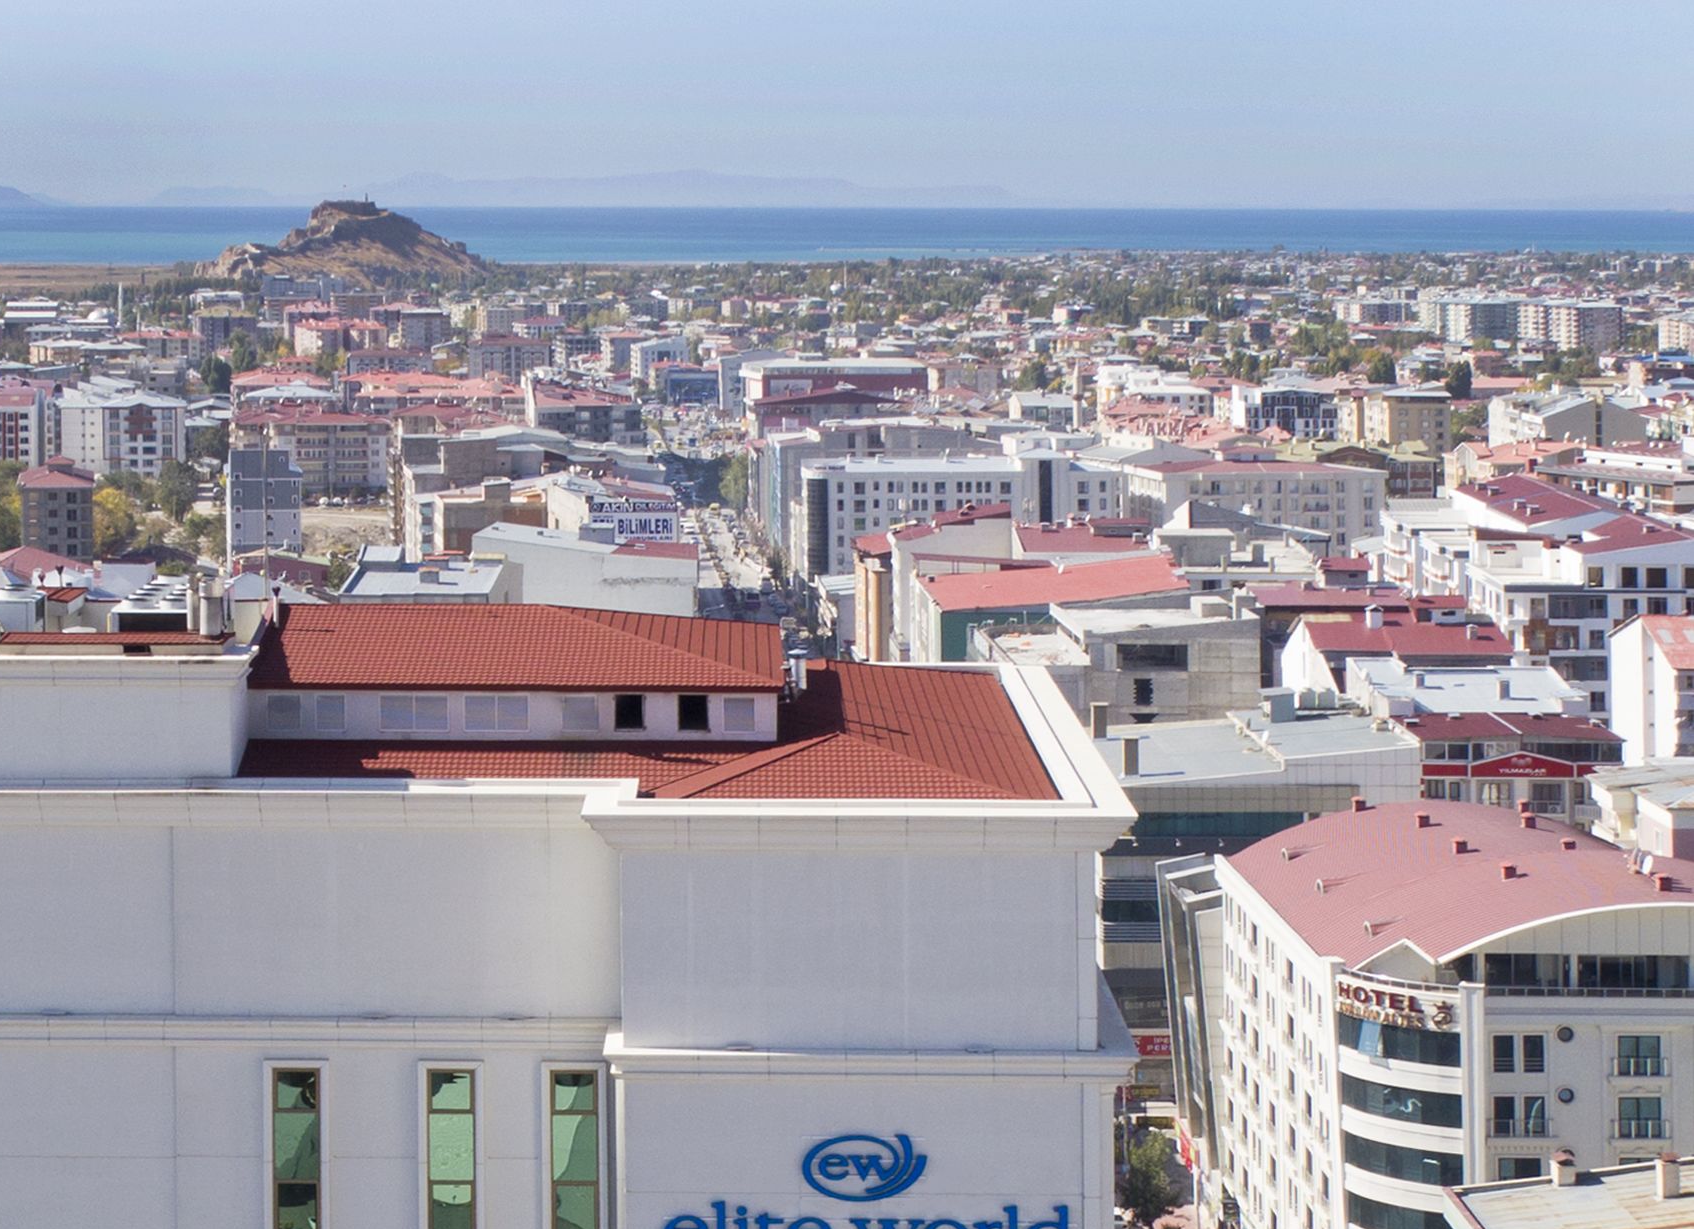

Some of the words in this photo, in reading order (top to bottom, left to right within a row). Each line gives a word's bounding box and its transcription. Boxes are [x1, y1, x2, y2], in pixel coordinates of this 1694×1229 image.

[602, 502, 633, 512] AKIN
[617, 518, 673, 535] BİLİMLERİ
[1338, 981, 1425, 1014] HOTEL
